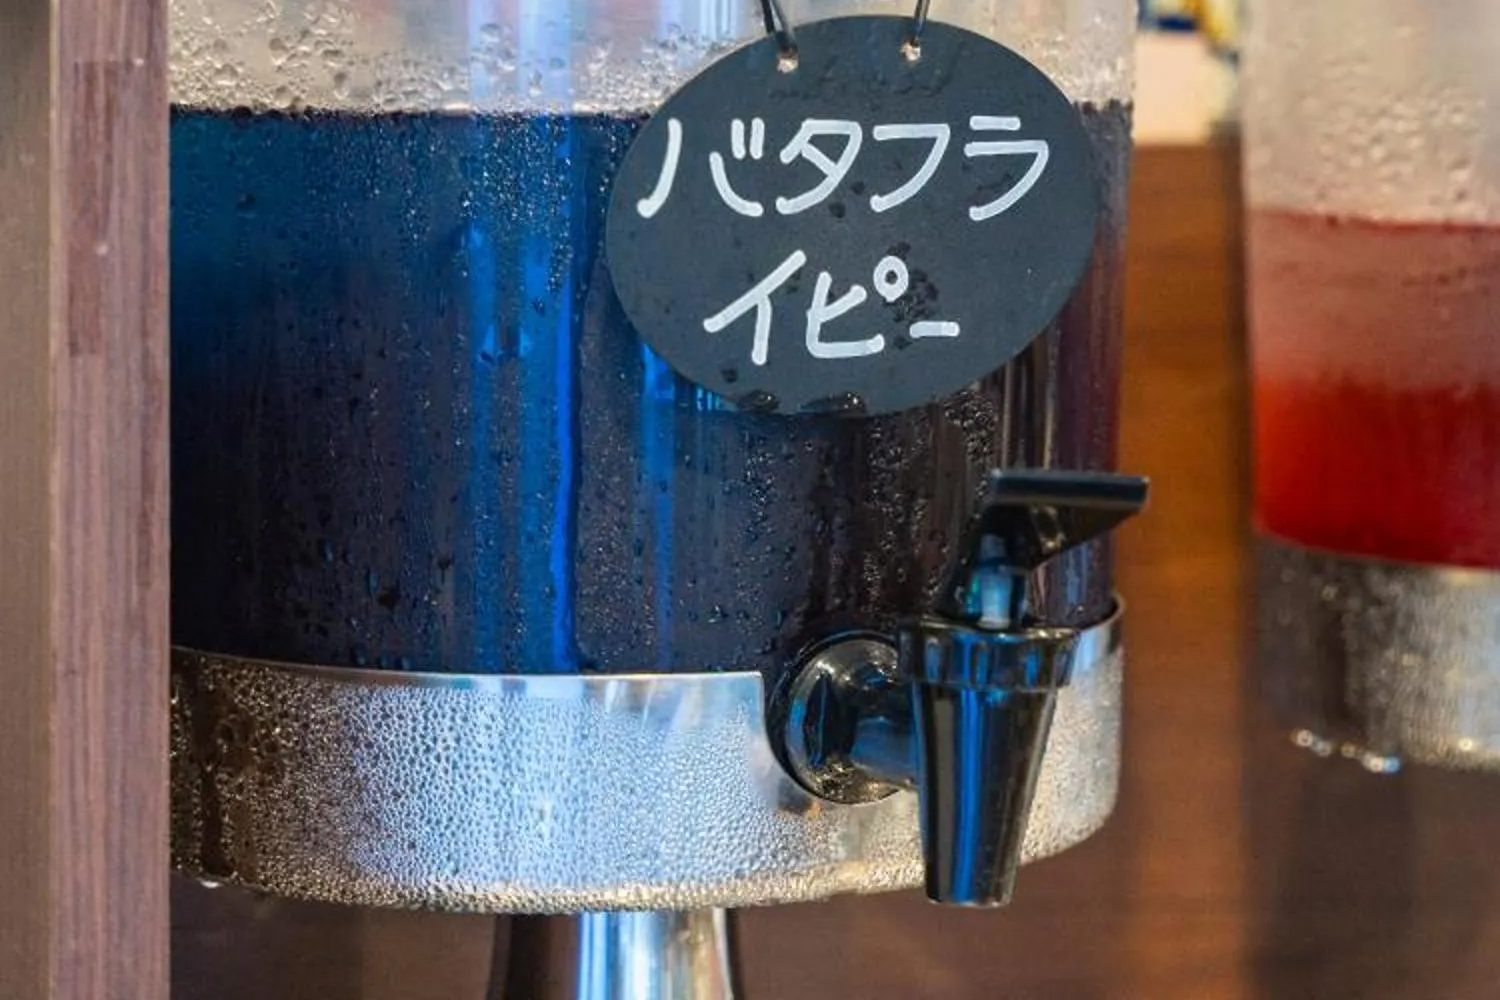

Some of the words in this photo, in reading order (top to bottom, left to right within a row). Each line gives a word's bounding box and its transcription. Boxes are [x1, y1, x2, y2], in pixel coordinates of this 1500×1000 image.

[637, 116, 1049, 221] バタフラ
[704, 250, 960, 365] イピー
